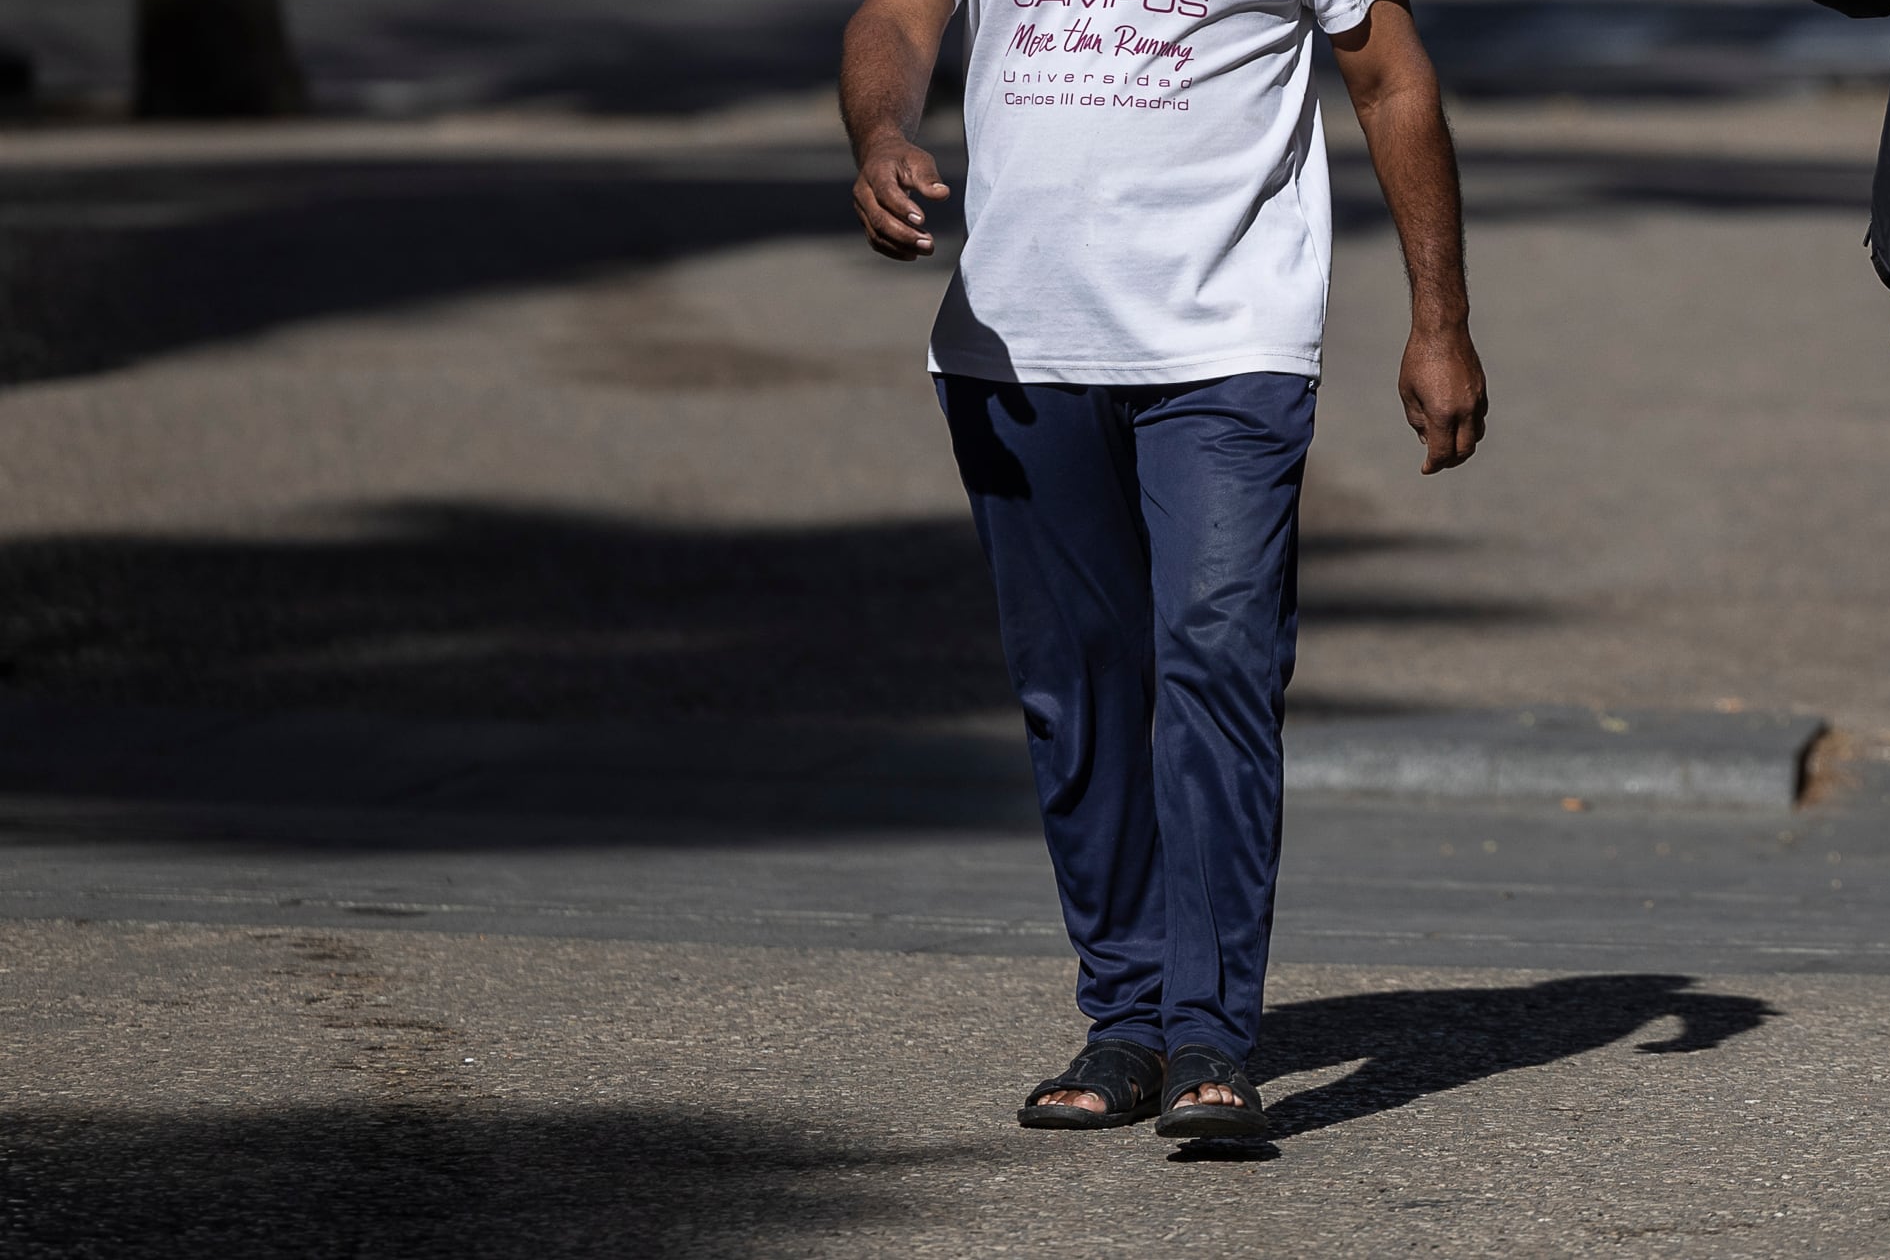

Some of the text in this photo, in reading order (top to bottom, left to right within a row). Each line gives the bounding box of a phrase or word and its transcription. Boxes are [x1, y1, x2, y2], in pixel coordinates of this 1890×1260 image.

[1005, 17, 1195, 72] More than Running
[1003, 70, 1193, 89] Universidad
[1004, 92, 1190, 111] Carlos III de Madrid
